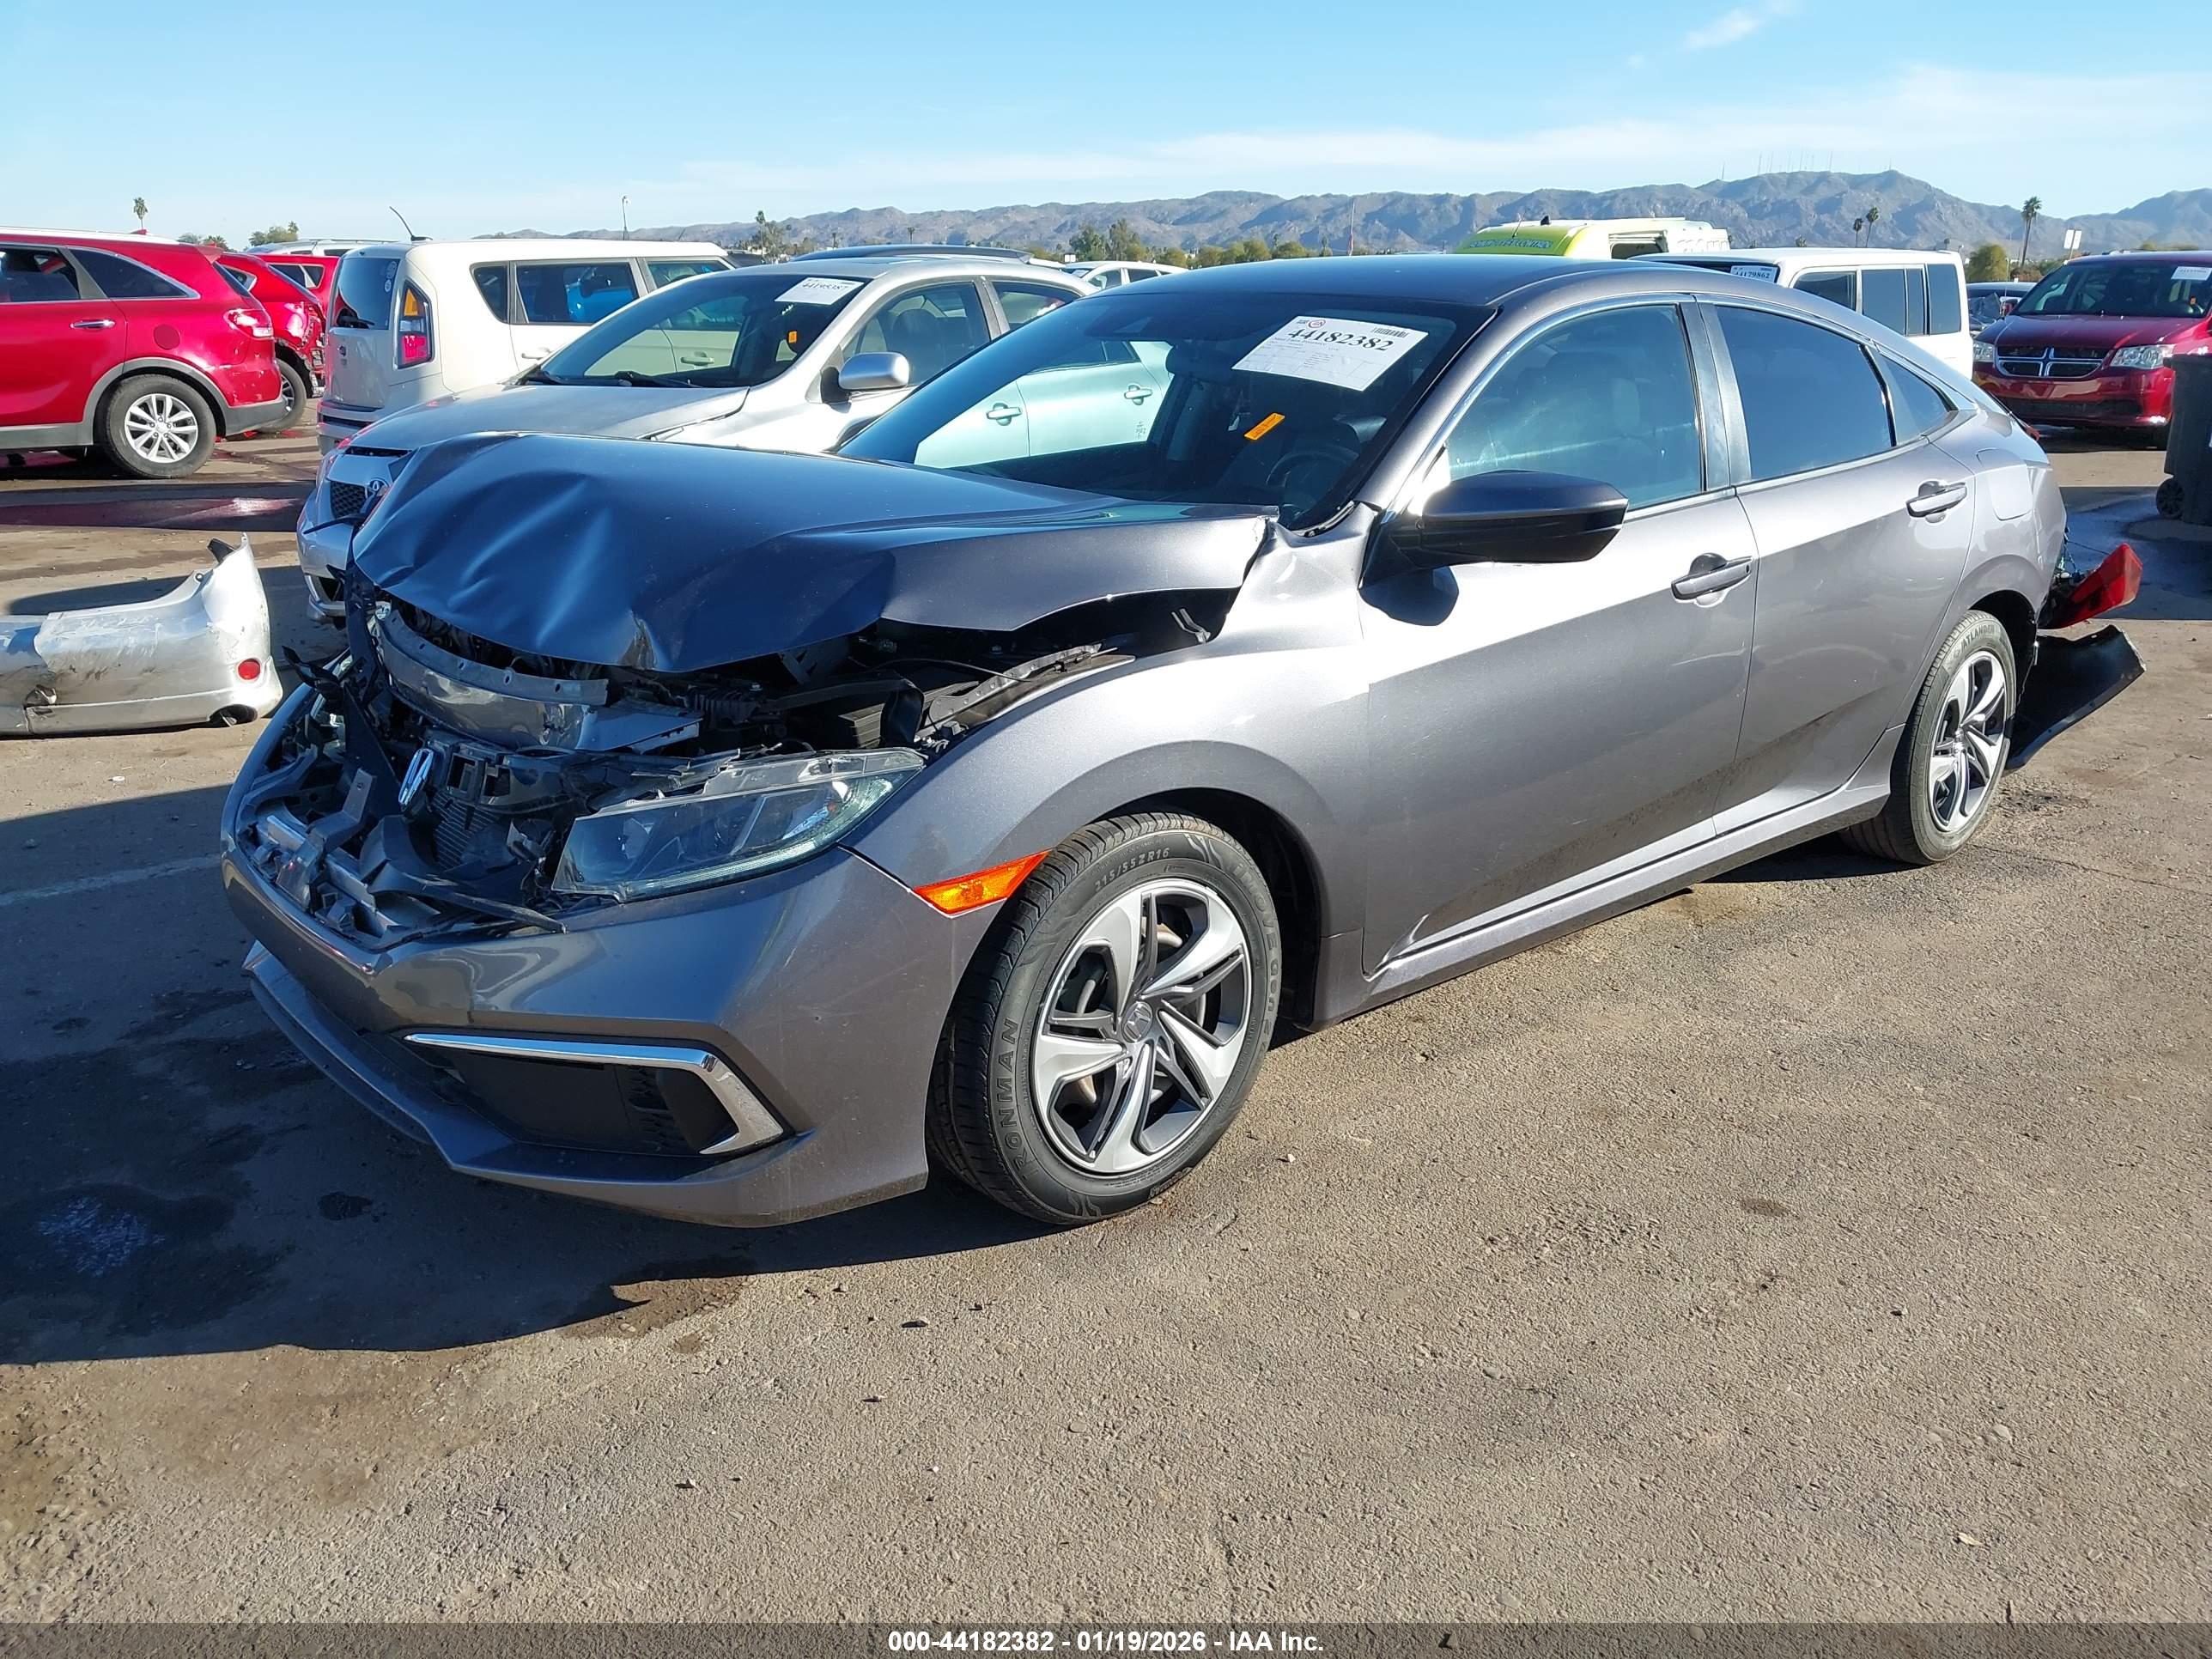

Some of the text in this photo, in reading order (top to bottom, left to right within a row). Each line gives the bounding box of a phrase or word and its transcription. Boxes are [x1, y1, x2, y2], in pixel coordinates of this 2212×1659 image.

[1288, 329, 1394, 351] 44182382
[1095, 848, 1170, 892] 215/55ZR16
[996, 1018, 1039, 1180] IRONMAN
